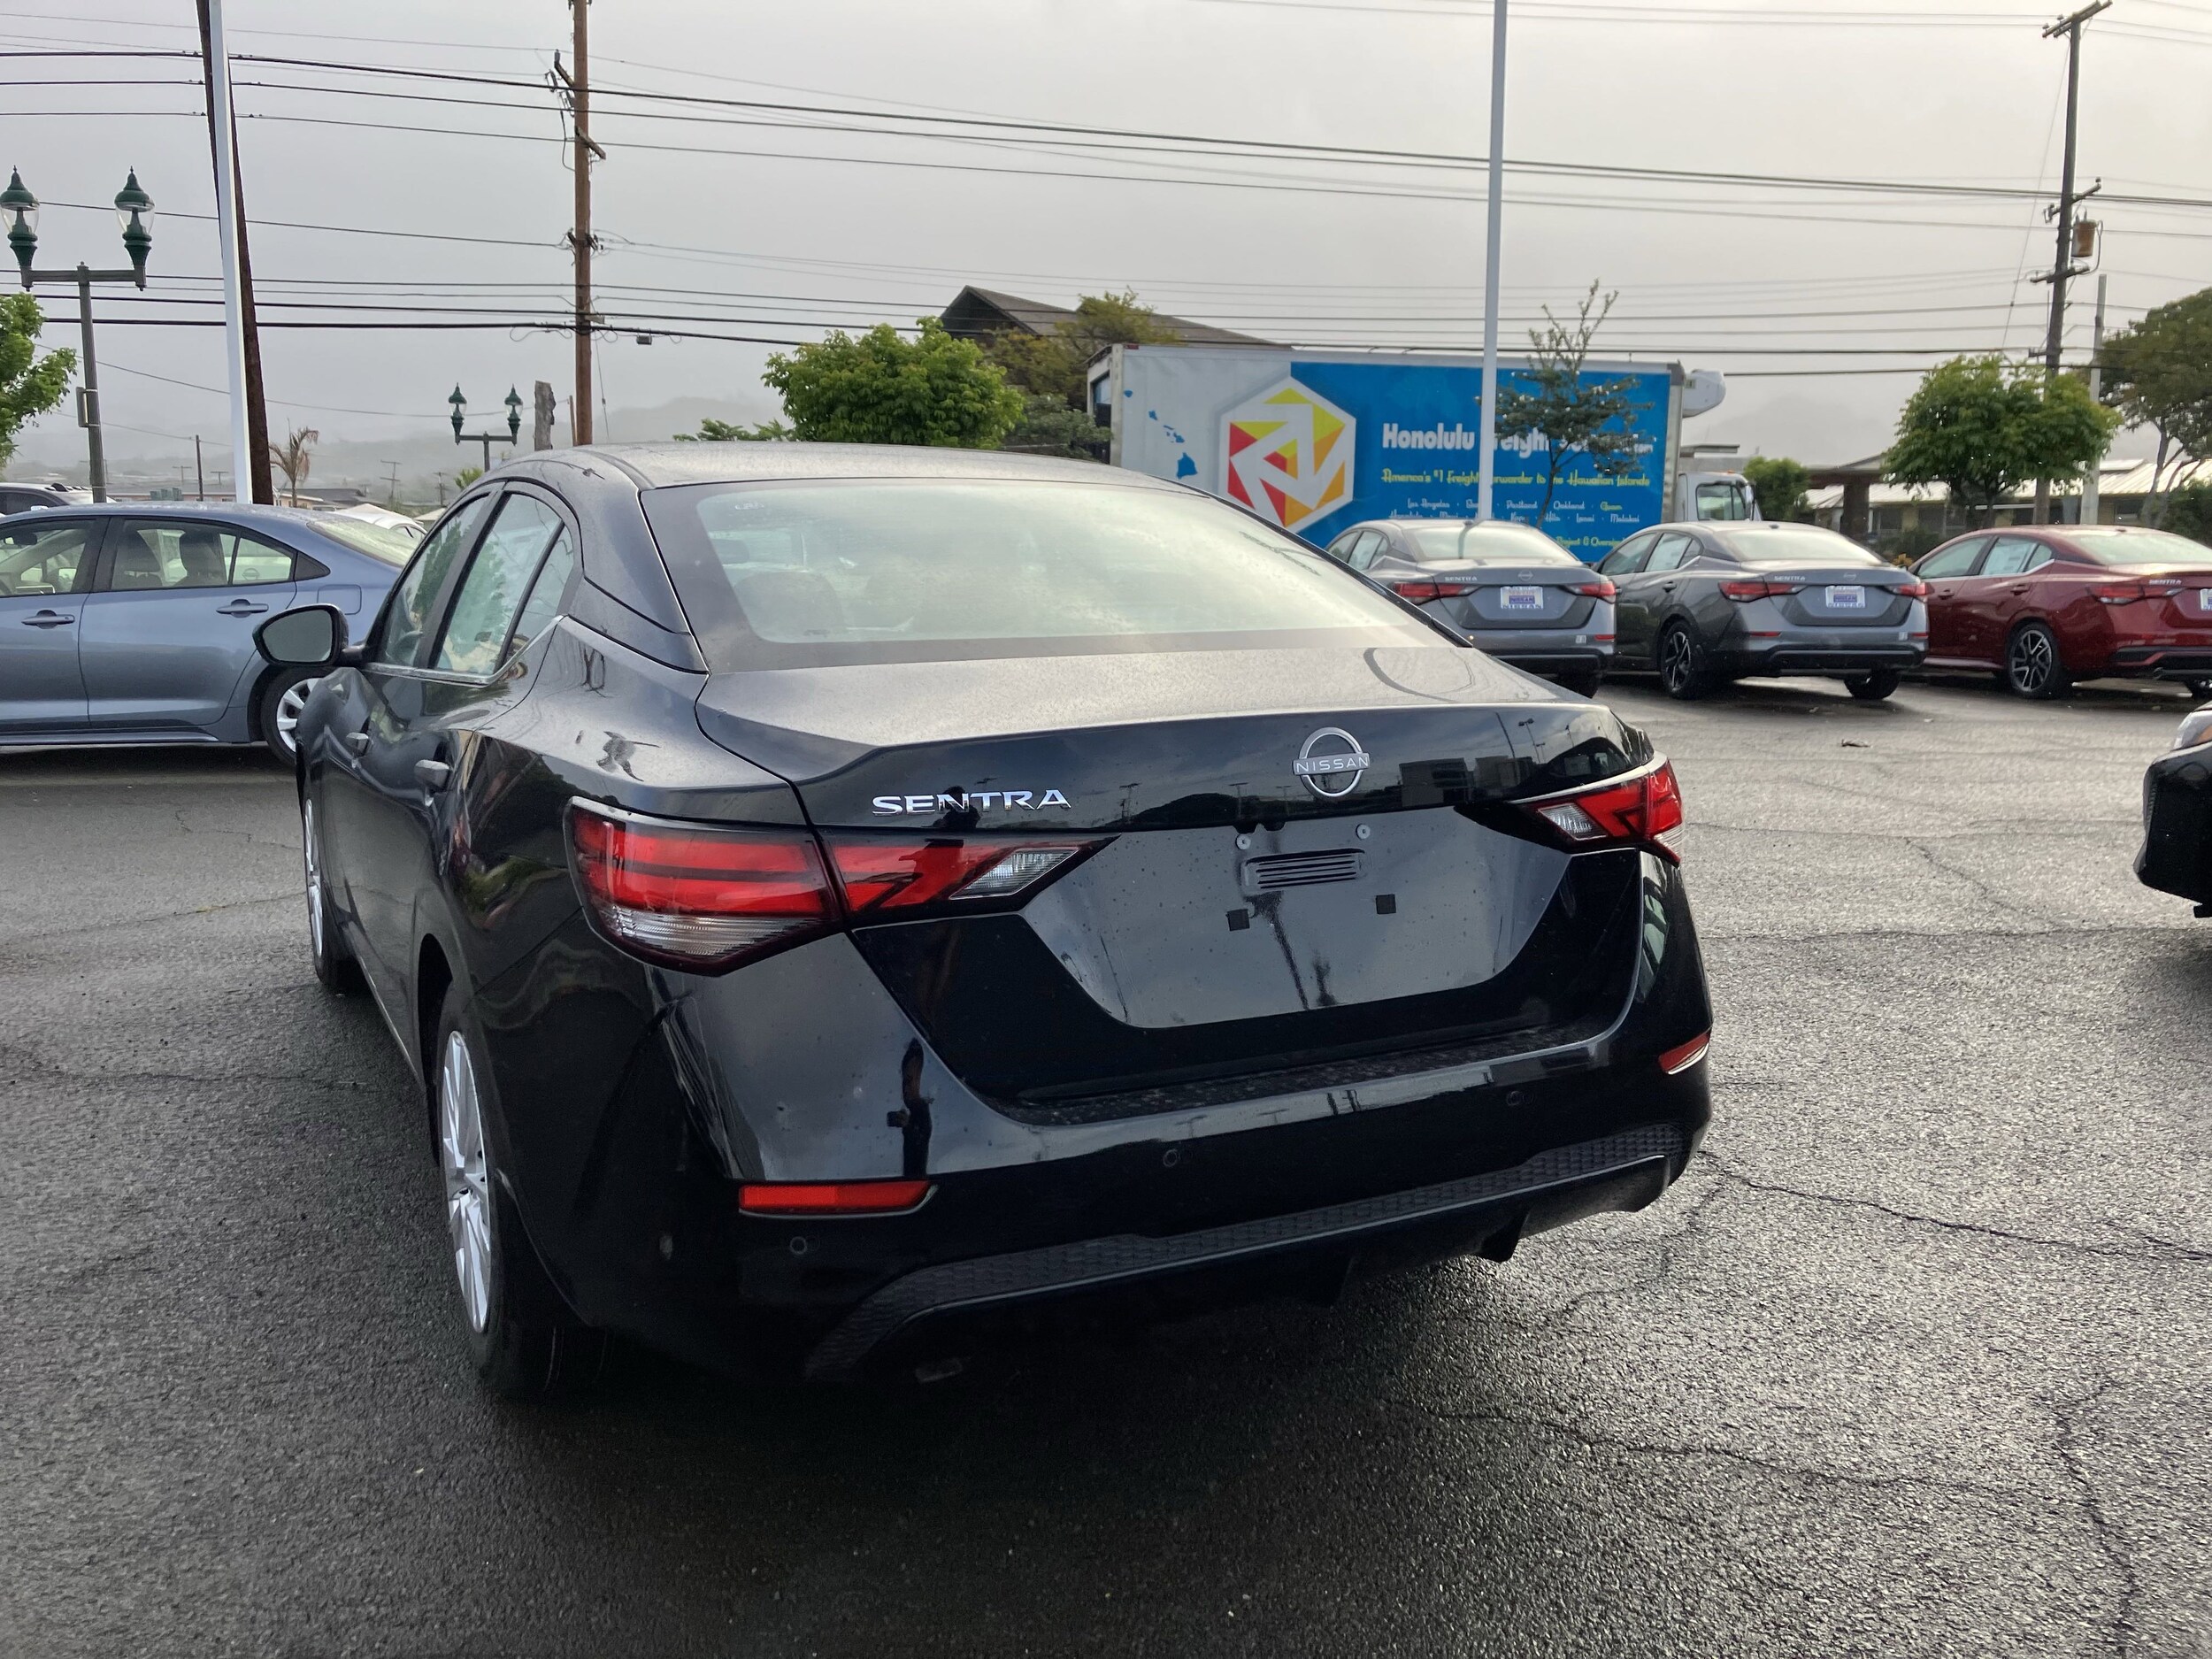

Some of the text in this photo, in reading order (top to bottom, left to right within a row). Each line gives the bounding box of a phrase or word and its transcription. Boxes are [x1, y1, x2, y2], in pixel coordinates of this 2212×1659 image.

[1382, 423, 1475, 449] Honolulu
[1536, 472, 1547, 484] to
[1296, 757, 1369, 772] NISSAN
[872, 789, 1071, 815] SENTRA
